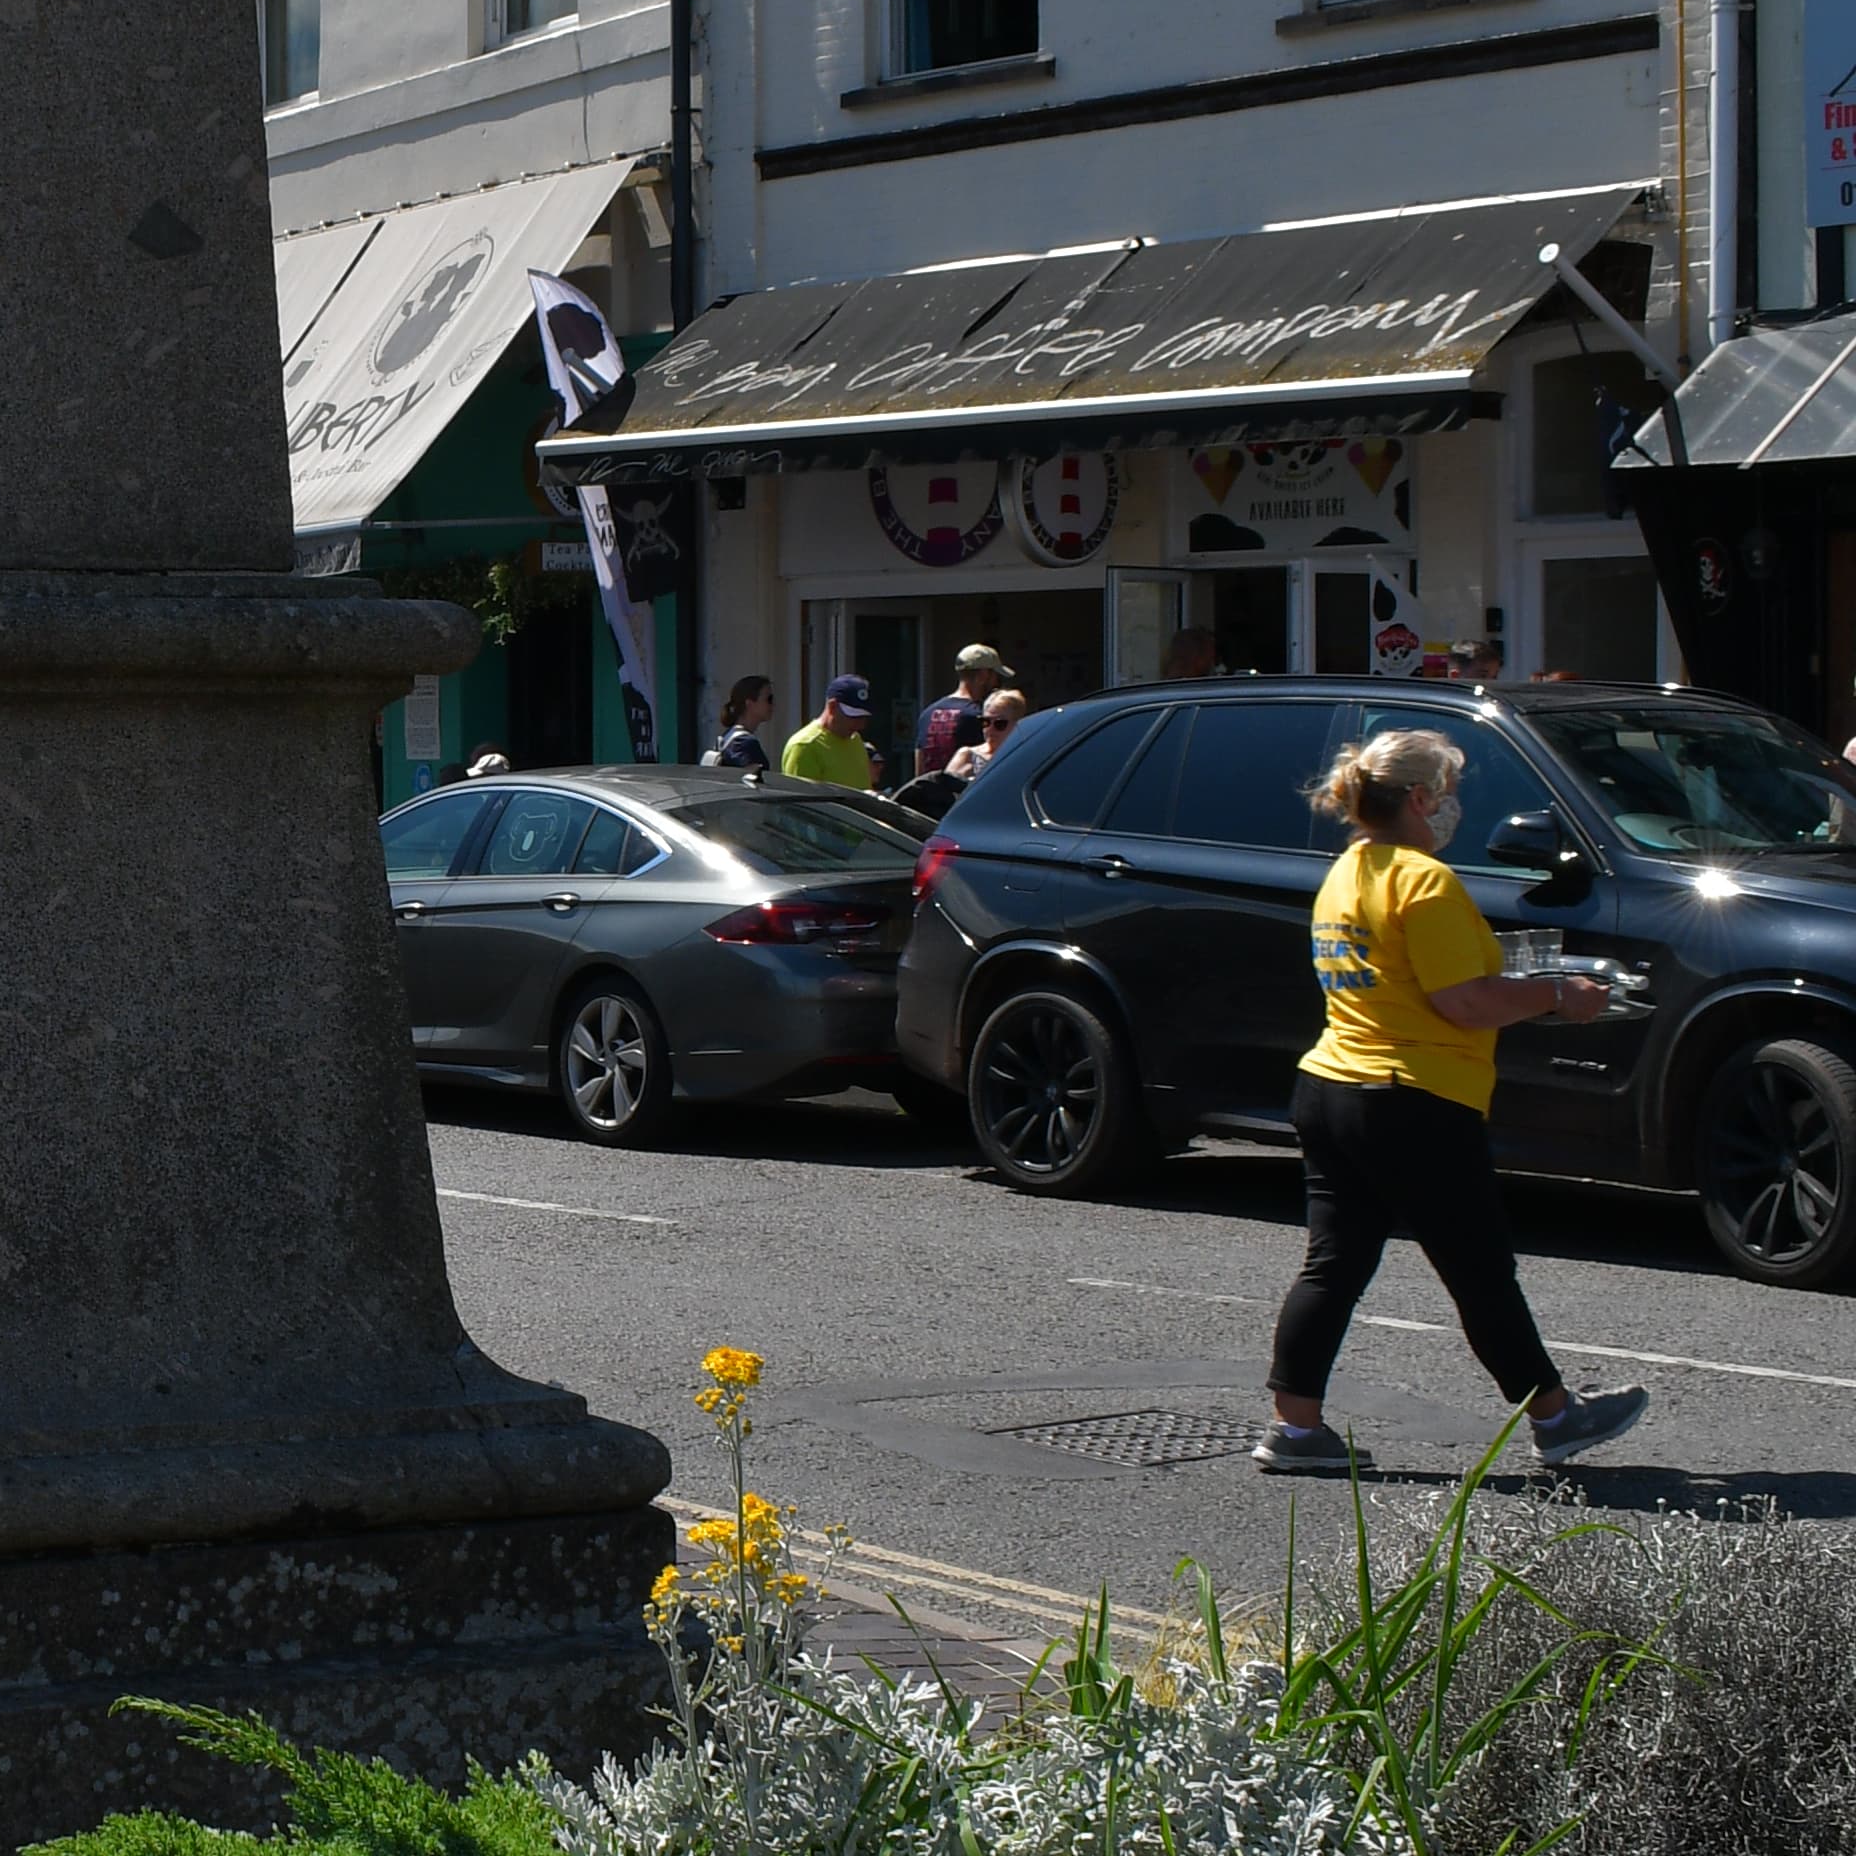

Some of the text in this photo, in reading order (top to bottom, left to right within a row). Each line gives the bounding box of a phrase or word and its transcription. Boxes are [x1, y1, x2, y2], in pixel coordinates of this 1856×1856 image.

[643, 338, 720, 388] The
[674, 360, 837, 414] Bay
[844, 322, 1147, 402] Coffee
[1249, 497, 1345, 521] AVAILABLE HERE
